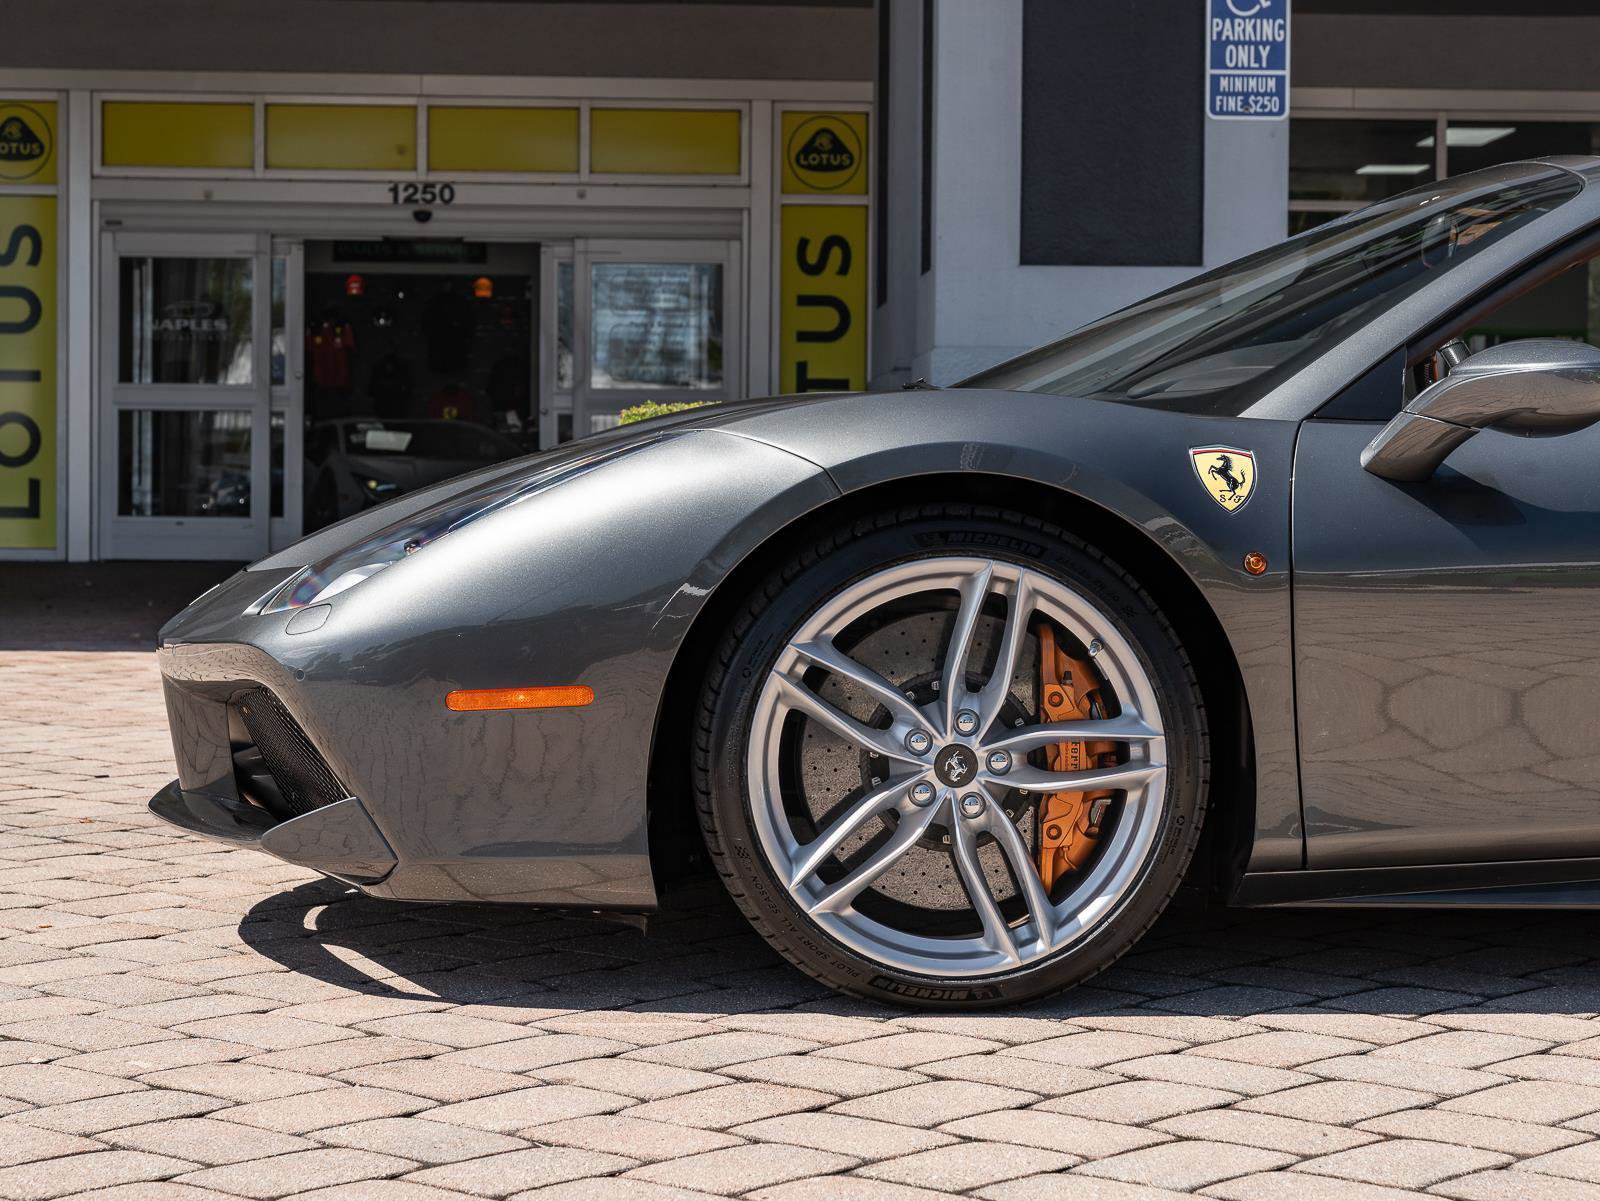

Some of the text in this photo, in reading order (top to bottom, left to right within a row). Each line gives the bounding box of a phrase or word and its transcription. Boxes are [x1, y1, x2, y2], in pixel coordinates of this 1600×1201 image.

[1212, 18, 1285, 42] PARKING
[1225, 44, 1271, 68] ONLY
[1219, 76, 1276, 93] MINIMUM
[1215, 94, 1280, 114] FINE $250
[0, 142, 41, 155] OTUS
[798, 153, 852, 166] LOTUS
[388, 183, 455, 205] 1250
[796, 234, 852, 391] TUS
[750, 875, 781, 915] SEASON
[781, 917, 798, 934] ALL
[797, 934, 831, 960] SPORT
[830, 959, 861, 978] PILOT
[871, 977, 968, 1000] MICHELIN
